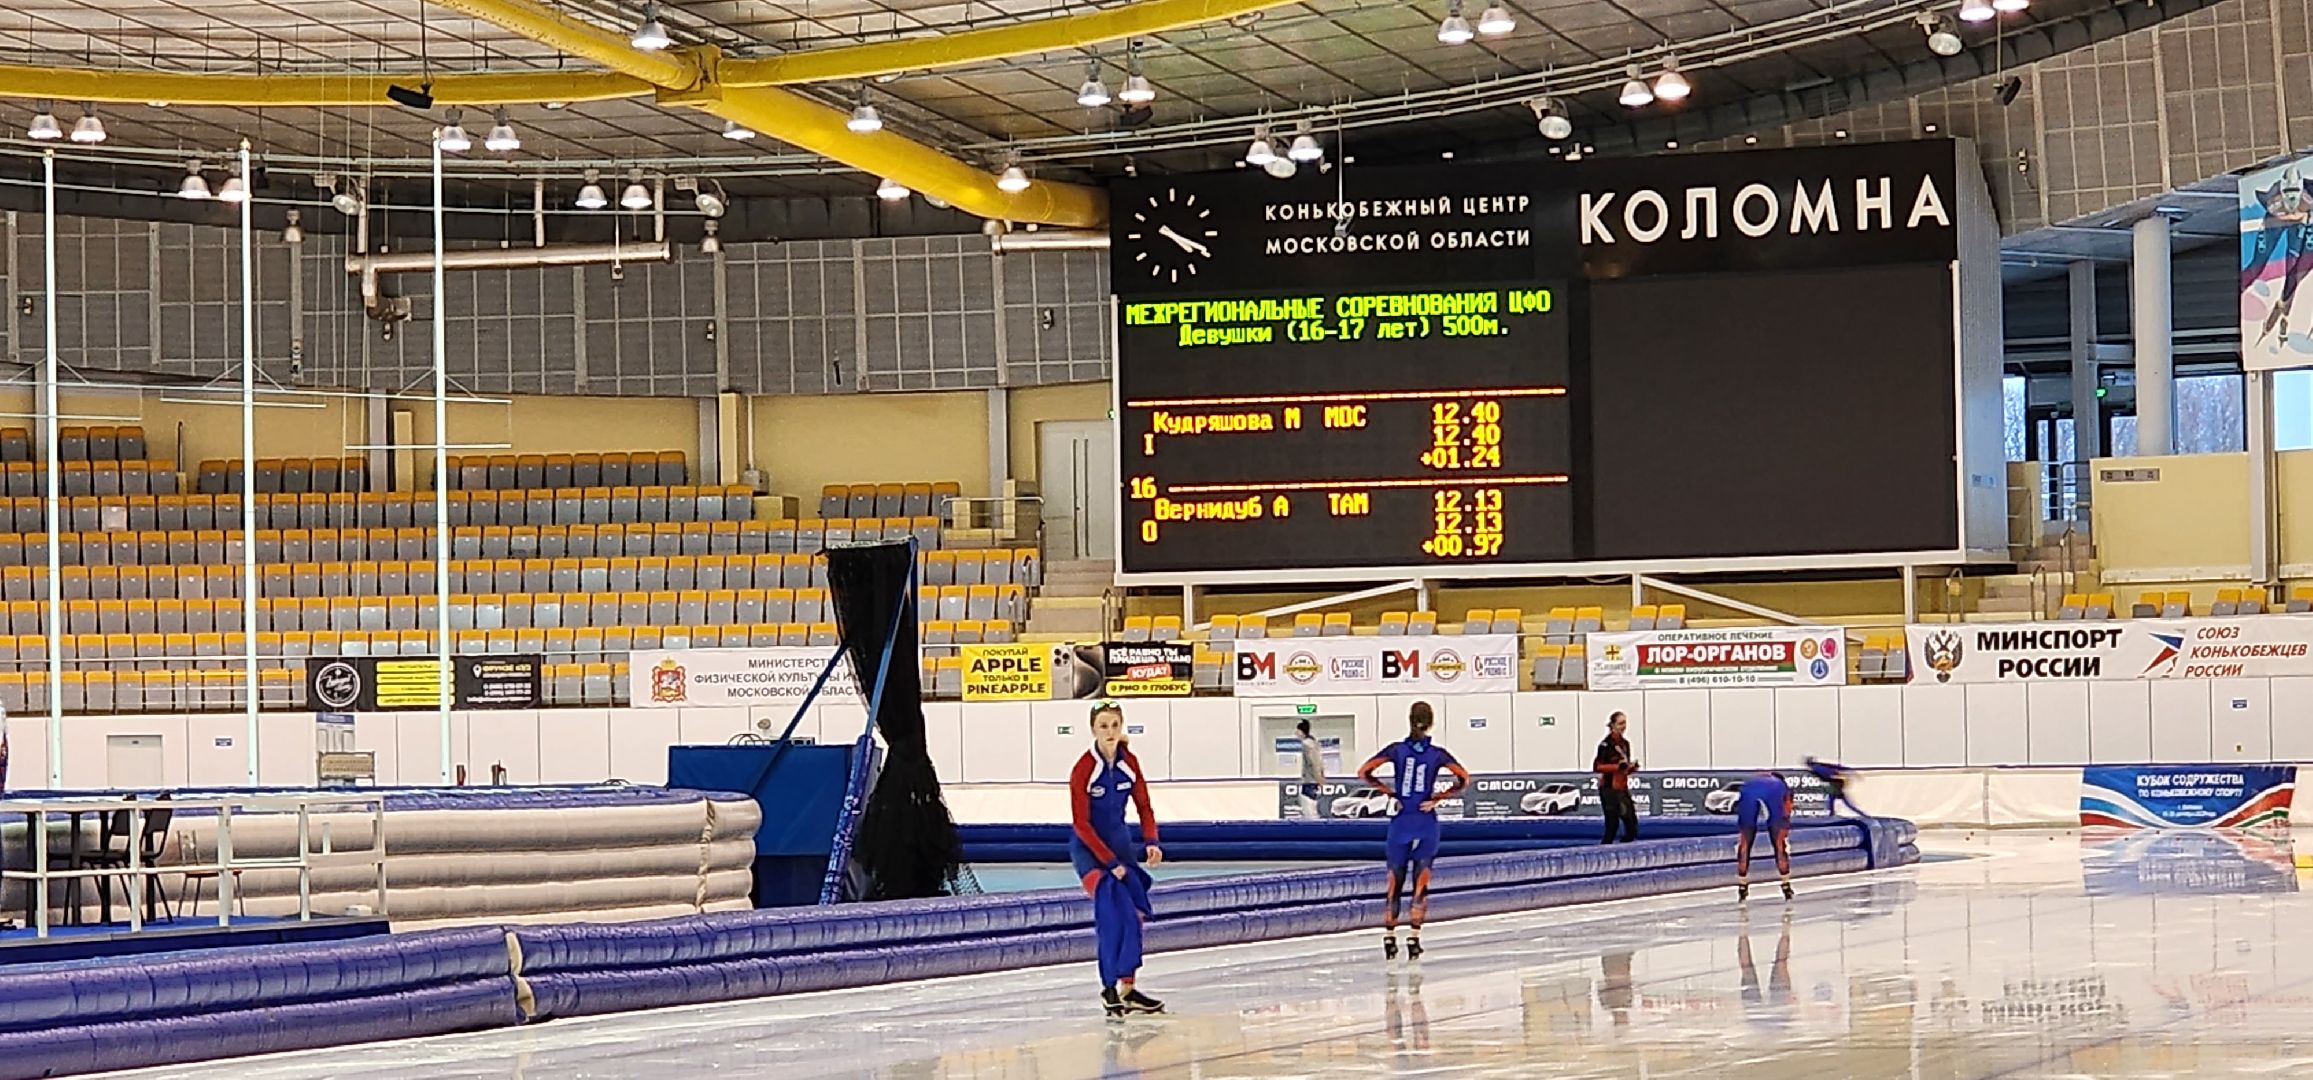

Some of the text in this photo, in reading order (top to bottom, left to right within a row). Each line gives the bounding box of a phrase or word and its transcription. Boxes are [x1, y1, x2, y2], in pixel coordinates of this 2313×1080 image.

[1265, 196, 1530, 221] КОНЬКОБЕЖНЫЙ ЦЕНТР
[1579, 173, 1951, 245] КОЛОМНА
[1265, 229, 1530, 255] МОСКОВСКОЙ ОБЛАСТИ
[1125, 290, 1551, 325] МЕЖРЕГИОНАЛЬНЫЕ СОРЕВНОВАНИЯ ЦФО
[1178, 314, 1510, 347] Девушки (16-17 лет) 500м.
[1152, 401, 1500, 437] Кудряшова М МОС 12.40
[1432, 424, 1501, 447] 12.40
[1420, 447, 1502, 469] +01.24
[1129, 477, 1158, 500] 16
[1154, 488, 1503, 521] Вернидуб А ТАМ 12.13
[1434, 511, 1503, 535] 12.13
[1422, 533, 1504, 557] +00.97
[1657, 631, 1773, 642] ОПЕРАТИВНОЕ ЛЕЧЕНИЕ
[1976, 628, 2123, 652] МИНСПОРТ
[2196, 626, 2241, 640] СОЮЗ
[982, 647, 1029, 657] ПОКУПАЙ
[1646, 644, 1787, 664] ЛОР-ОРГАНОВ
[2190, 643, 2308, 660] КОНЬКОБЕЖЦЕВ
[748, 658, 844, 669] МИНИСТЕРСТО
[970, 656, 1043, 673] APPLE
[1998, 656, 2101, 679] РОССИИ
[2184, 663, 2244, 679] РОССИИ
[694, 671, 776, 684] ФИЗИЧЕСКОЙ
[778, 672, 840, 683] КУЛЬТУЫ
[967, 682, 1046, 694] PINEAPPLE
[983, 674, 1021, 682] ТОЛЬКО
[1712, 675, 1756, 684] 610-10-10
[727, 685, 809, 697] МОСКОВСКОЙ
[2136, 773, 2245, 787] КУБОК СОДРУЖЕСТВА
